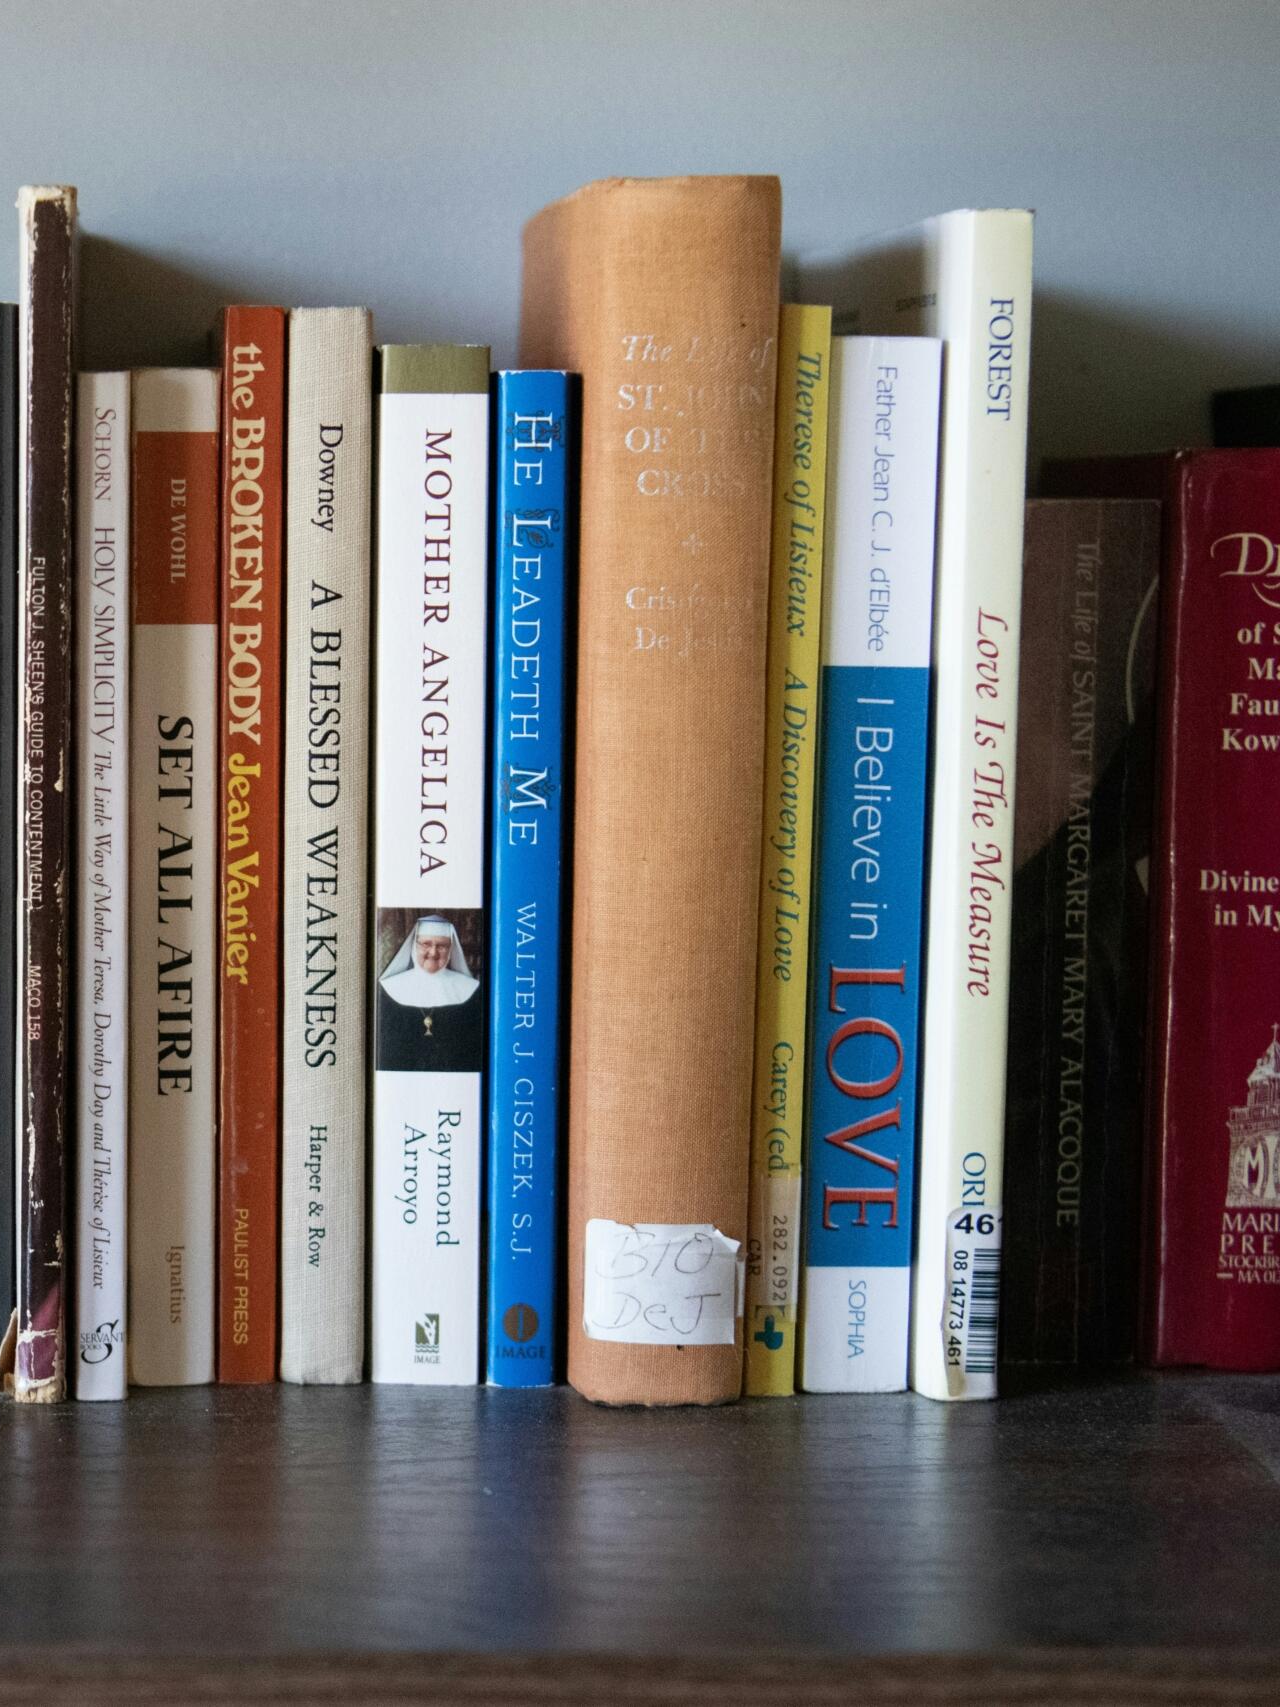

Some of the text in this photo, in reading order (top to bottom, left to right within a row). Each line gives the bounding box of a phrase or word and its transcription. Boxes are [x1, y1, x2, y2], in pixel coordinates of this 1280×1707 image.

[621, 335, 673, 363] The
[986, 297, 1014, 421] FOREST
[624, 426, 672, 453] OF
[170, 479, 186, 584] DE WOHL
[867, 366, 897, 652] Father Jean C. J. d'Elbée
[226, 342, 265, 985] the BROKEN BODY Jean Vanier
[419, 428, 453, 877] MOTHER ANGELICA
[508, 411, 553, 846] HE LEADETH ME
[771, 352, 822, 982] Therese of Lisieux A Discovery of Love
[1237, 623, 1264, 644] of
[29, 556, 46, 902] FULTON SHEEN'S GUIDE TO CONTENTMENT
[304, 423, 343, 1068] Downey A BLESSED WEAKNESS
[87, 407, 117, 1289] SCHORN HOLY SIMPLICITY The Little Way of Mother Dorothy Day and Thérèse of Lisieux
[968, 607, 1008, 998] Love Is The Measure
[157, 715, 194, 1096] SET ALL AFIRE
[1056, 541, 1103, 1228] The Life of SAINT MARGARET MARY ALACOQUE
[1199, 870, 1280, 894] Divine
[1214, 904, 1238, 926] in
[28, 965, 42, 1040] MACO 158
[823, 726, 907, 1230] Believe in LOVE
[510, 902, 536, 1261] WALTER J. S.J.
[760, 1042, 795, 1117] Carey
[304, 1124, 327, 1267] Harper & Row
[394, 1123, 427, 1225] Arroyo
[435, 1110, 462, 1247] Raymond
[167, 1246, 184, 1323] Ignatius
[233, 1208, 248, 1344] PAULIST PRESS
[748, 1240, 761, 1276] CAR
[773, 1216, 787, 1301] 282.092
[846, 1279, 867, 1358] SOPHIA
[948, 1250, 969, 1367] 08 14773 461
[414, 1355, 440, 1364] IMAGE
[497, 1345, 547, 1360] IMAGE
